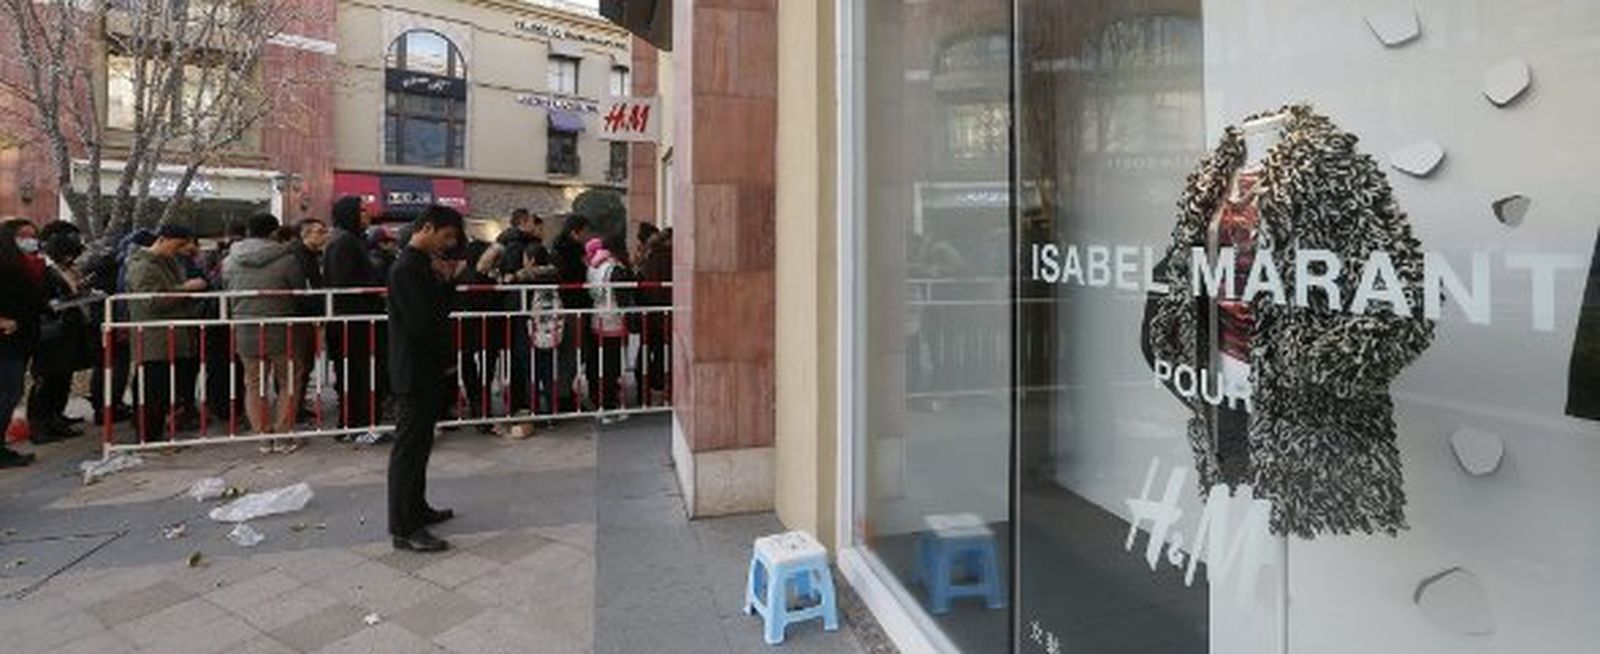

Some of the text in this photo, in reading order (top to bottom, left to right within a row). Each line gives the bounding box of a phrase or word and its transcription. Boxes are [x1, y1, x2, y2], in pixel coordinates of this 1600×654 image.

[1031, 243, 1586, 331] ISABEL MARANT
[1153, 358, 1253, 414] POUR
[1124, 456, 1273, 606] H&M
